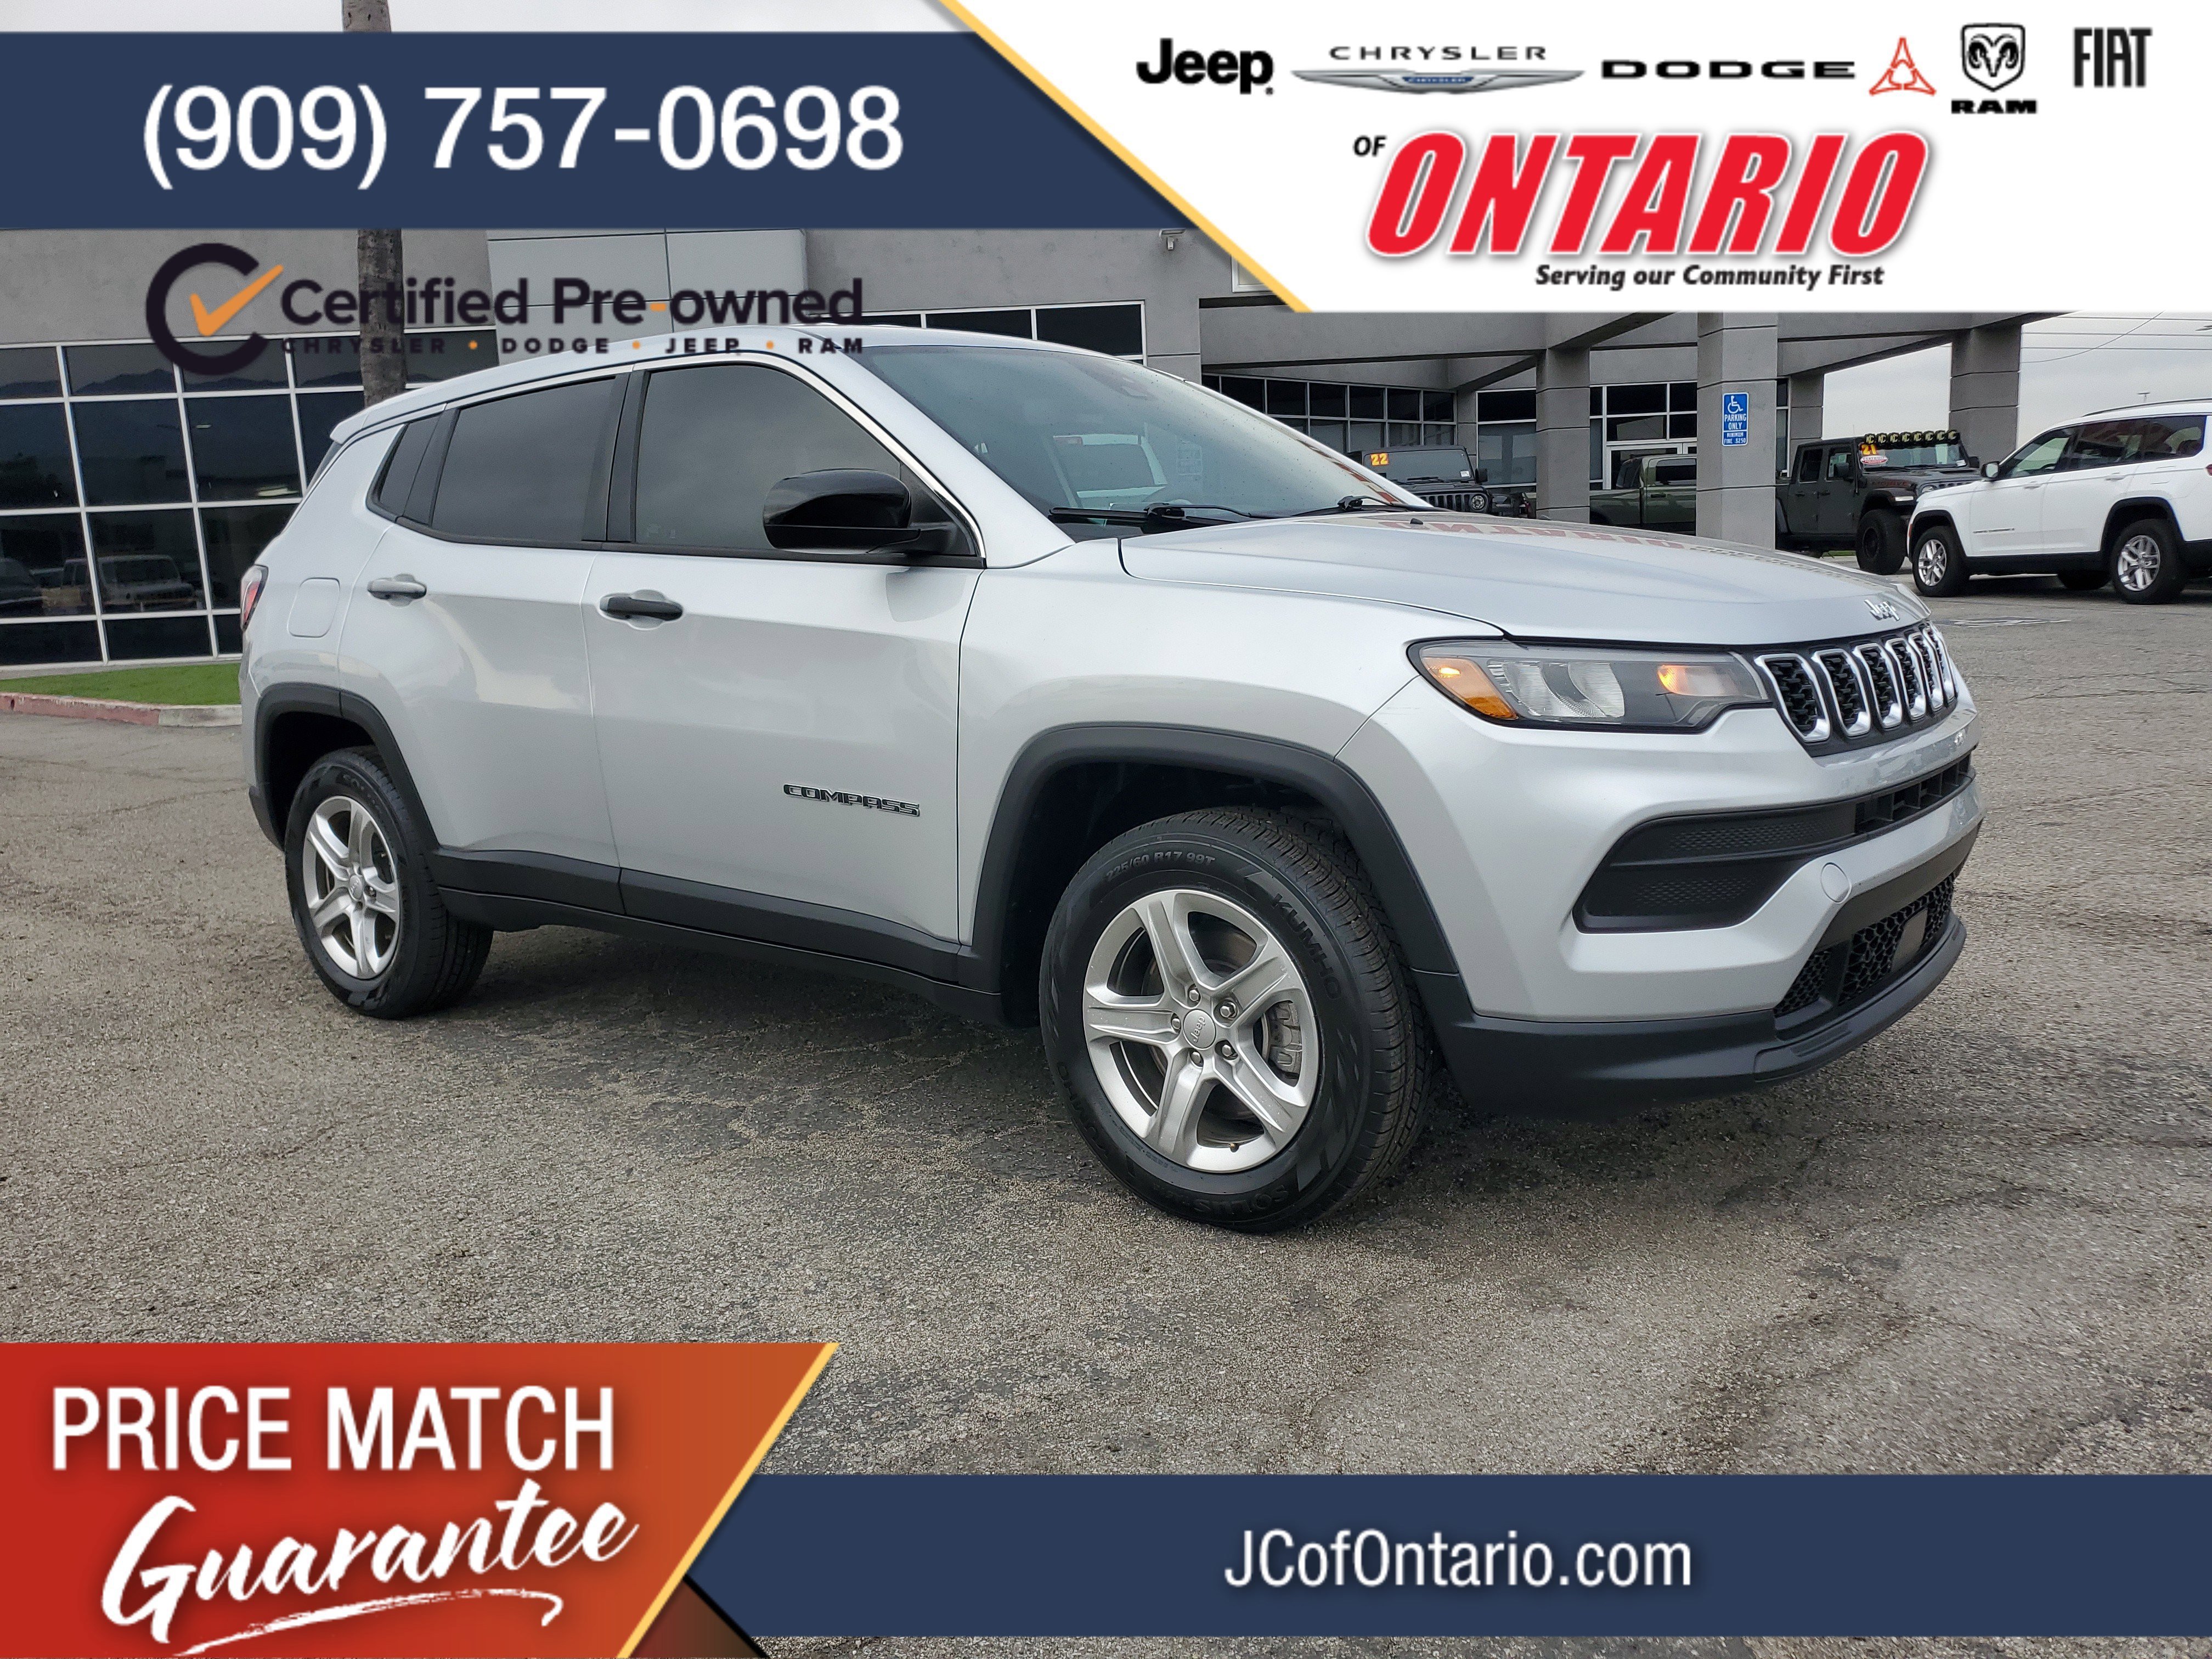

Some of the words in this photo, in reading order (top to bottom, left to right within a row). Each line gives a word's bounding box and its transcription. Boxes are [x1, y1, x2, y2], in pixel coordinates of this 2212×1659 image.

[1724, 413, 1747, 422] PARKING
[1728, 422, 1742, 430] ONLY
[1370, 453, 1388, 466] 22
[782, 783, 921, 817] COMPASS
[1154, 851, 1183, 864] R17
[1186, 852, 1216, 866] 99T
[1271, 892, 1342, 1001] KUMHO
[1190, 1016, 1206, 1043] Jeep
